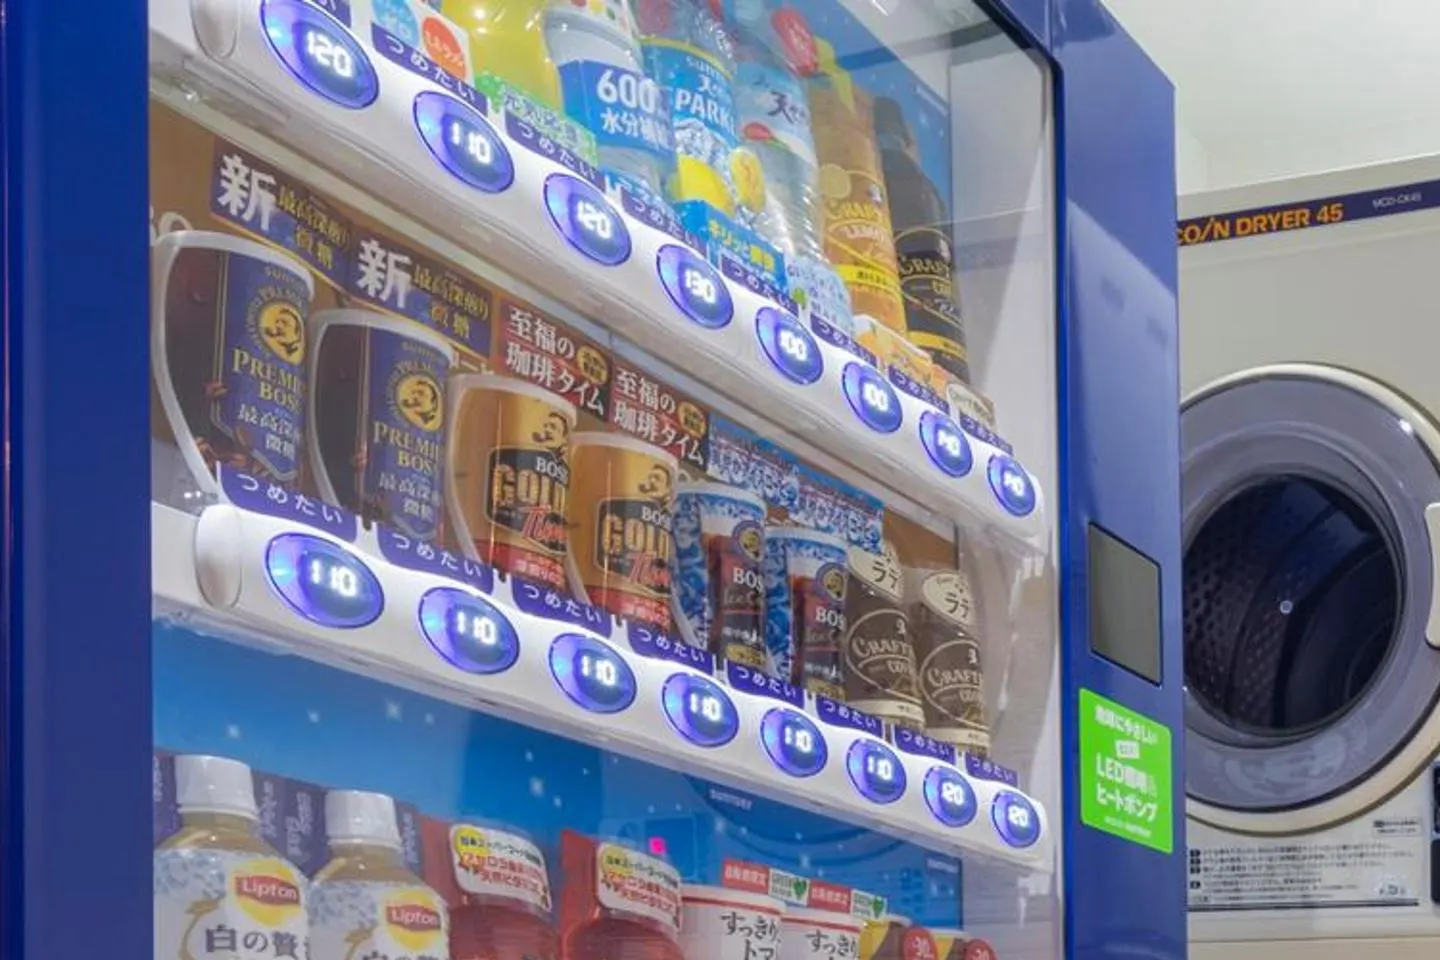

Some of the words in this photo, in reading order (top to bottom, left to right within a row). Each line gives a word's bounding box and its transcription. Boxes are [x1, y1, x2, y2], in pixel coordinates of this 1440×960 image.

[306, 30, 353, 77] 120
[388, 32, 474, 101] つめたい
[597, 69, 656, 114] 600
[451, 121, 492, 164] 110
[517, 121, 596, 181] つめたい
[217, 153, 278, 234] 新
[577, 200, 611, 239] 120
[634, 202, 700, 250] つめたい
[1236, 206, 1310, 237] DRYER
[1316, 203, 1345, 224] 45
[356, 238, 414, 309] 新
[685, 270, 716, 304] 130
[508, 305, 576, 360] 至福の
[506, 341, 605, 417] 珈琲タイム
[616, 366, 678, 415] 至福の
[613, 400, 704, 466] 珈琲タイム
[237, 473, 342, 525] つめたい
[392, 533, 484, 578] つめたい
[310, 558, 358, 598] 110
[524, 584, 603, 623] つめたい
[456, 611, 498, 645] 110
[636, 628, 706, 665] つめたい
[582, 655, 617, 686] 110
[736, 665, 797, 698] つめたい
[689, 694, 723, 722] 110
[823, 701, 878, 730] つめたい
[784, 726, 812, 753] 110
[900, 731, 952, 757] つめたい
[868, 755, 893, 781] 110
[241, 878, 299, 902] Lipton
[391, 908, 438, 926] Lipton
